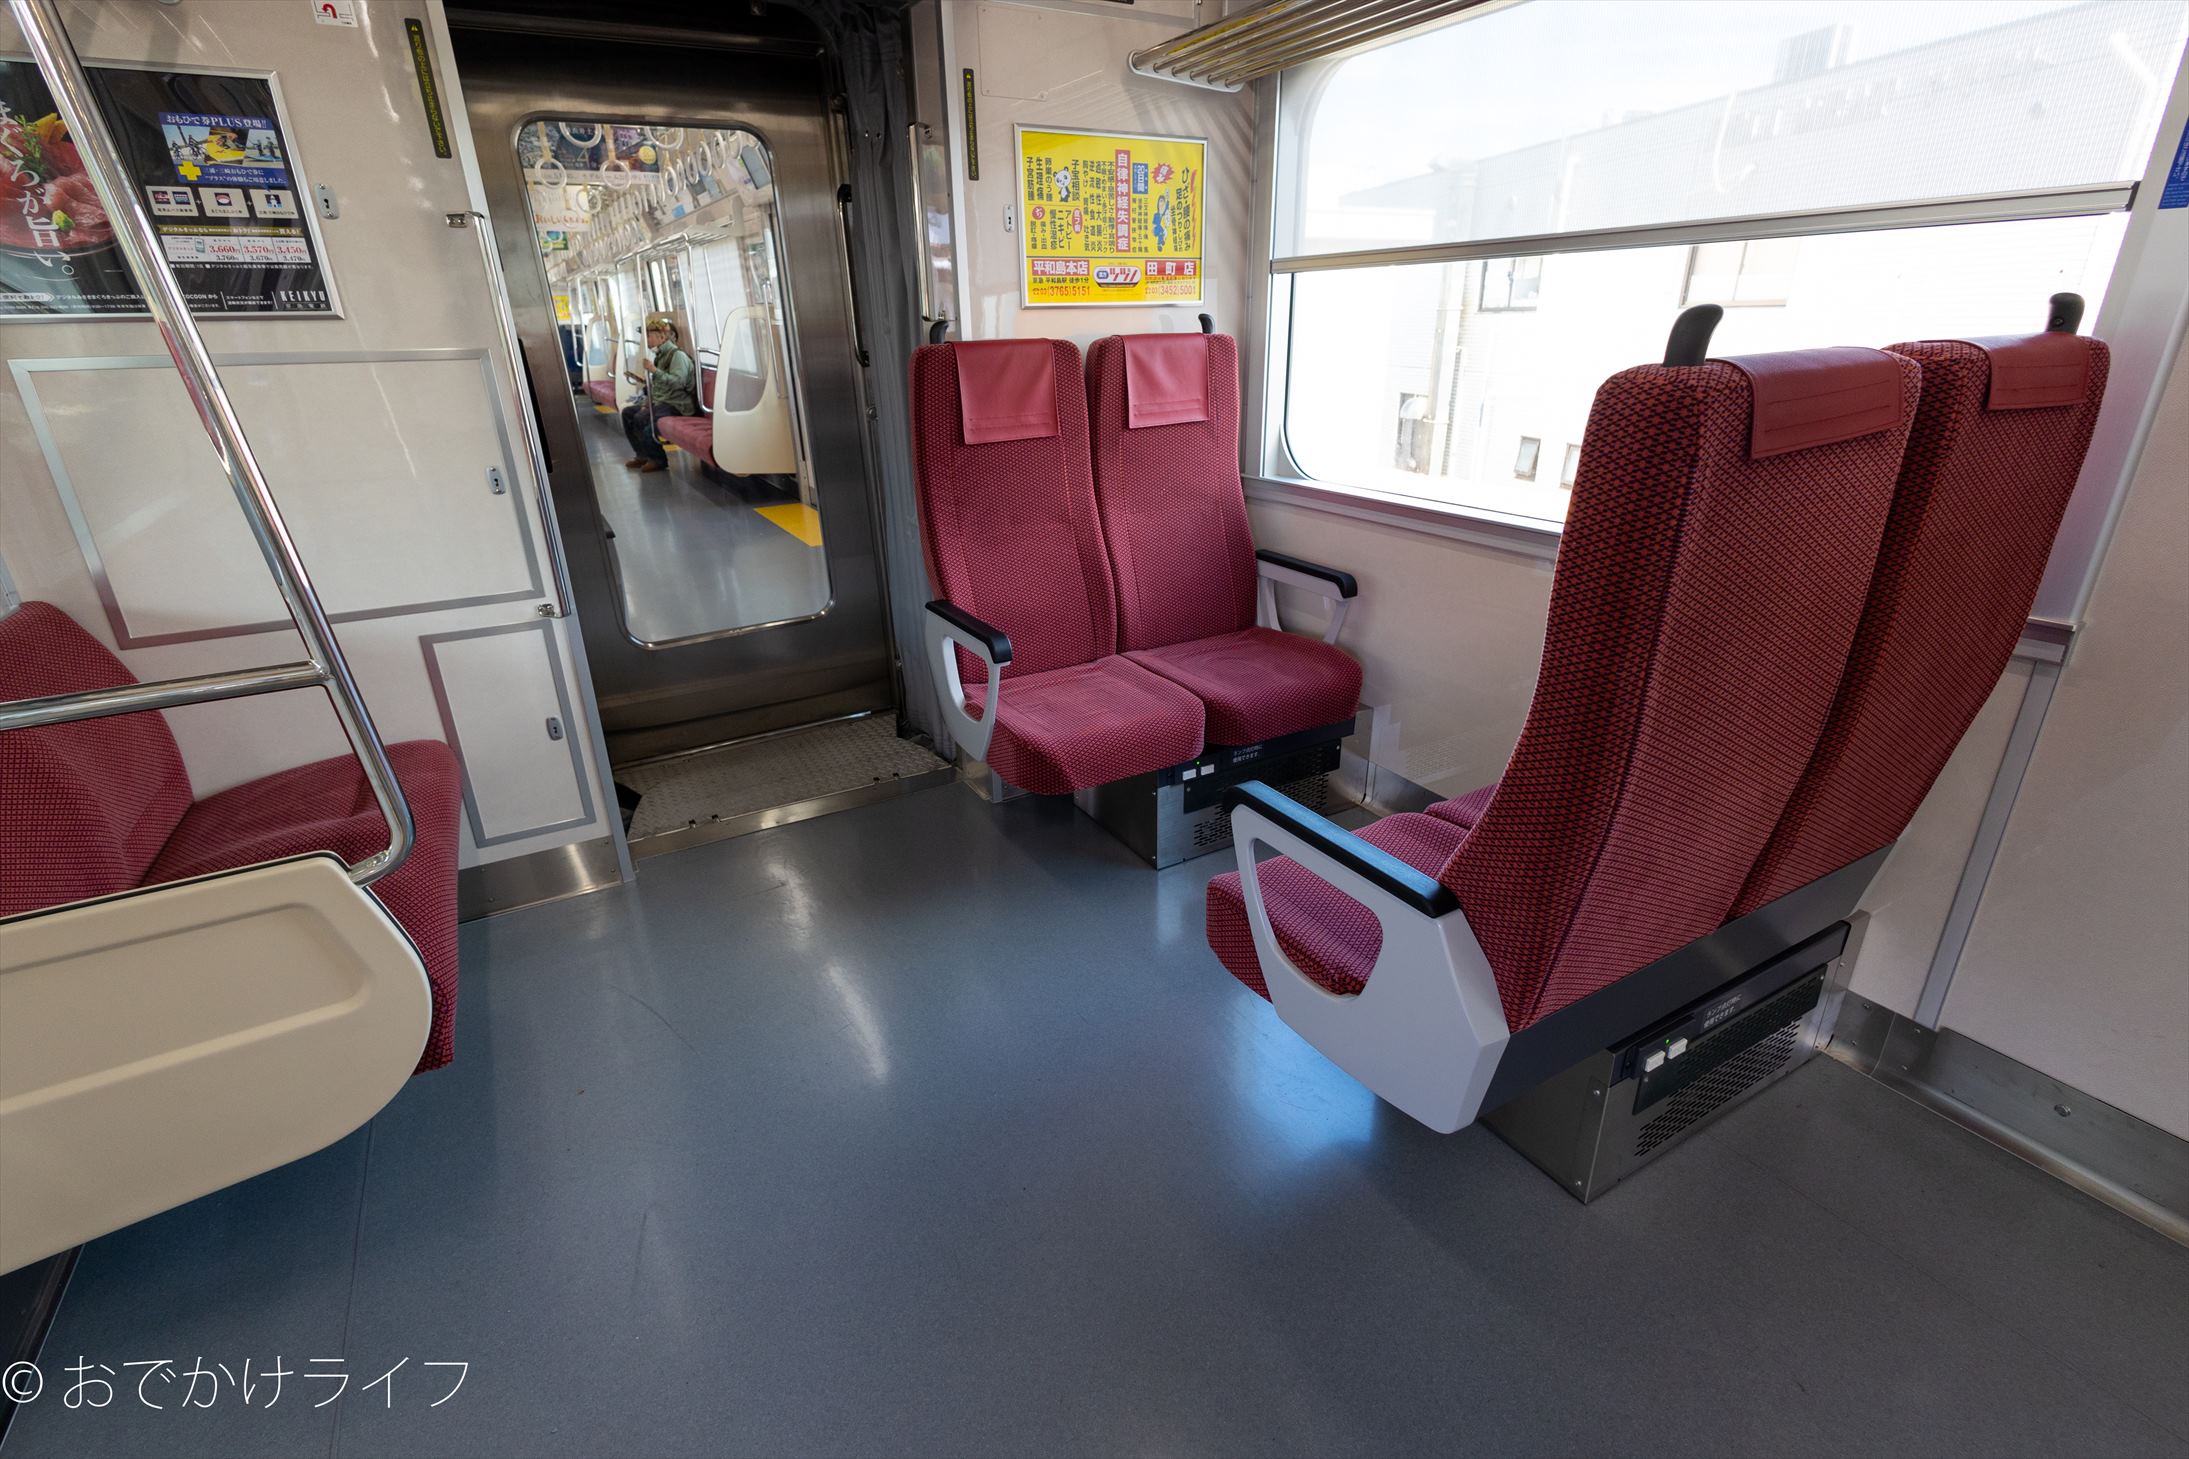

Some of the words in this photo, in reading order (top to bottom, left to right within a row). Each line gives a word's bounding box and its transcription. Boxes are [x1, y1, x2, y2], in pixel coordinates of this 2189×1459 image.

[1036, 156, 1044, 200] 生理痛
[1071, 159, 1080, 201] 子宝相談
[1117, 153, 1129, 250] 自律神経失調症
[1064, 209, 1072, 250] アトピー
[1033, 260, 1089, 275] 平和島本店
[1146, 261, 1195, 275] 田町店
[280, 291, 327, 302] KEIKYU
